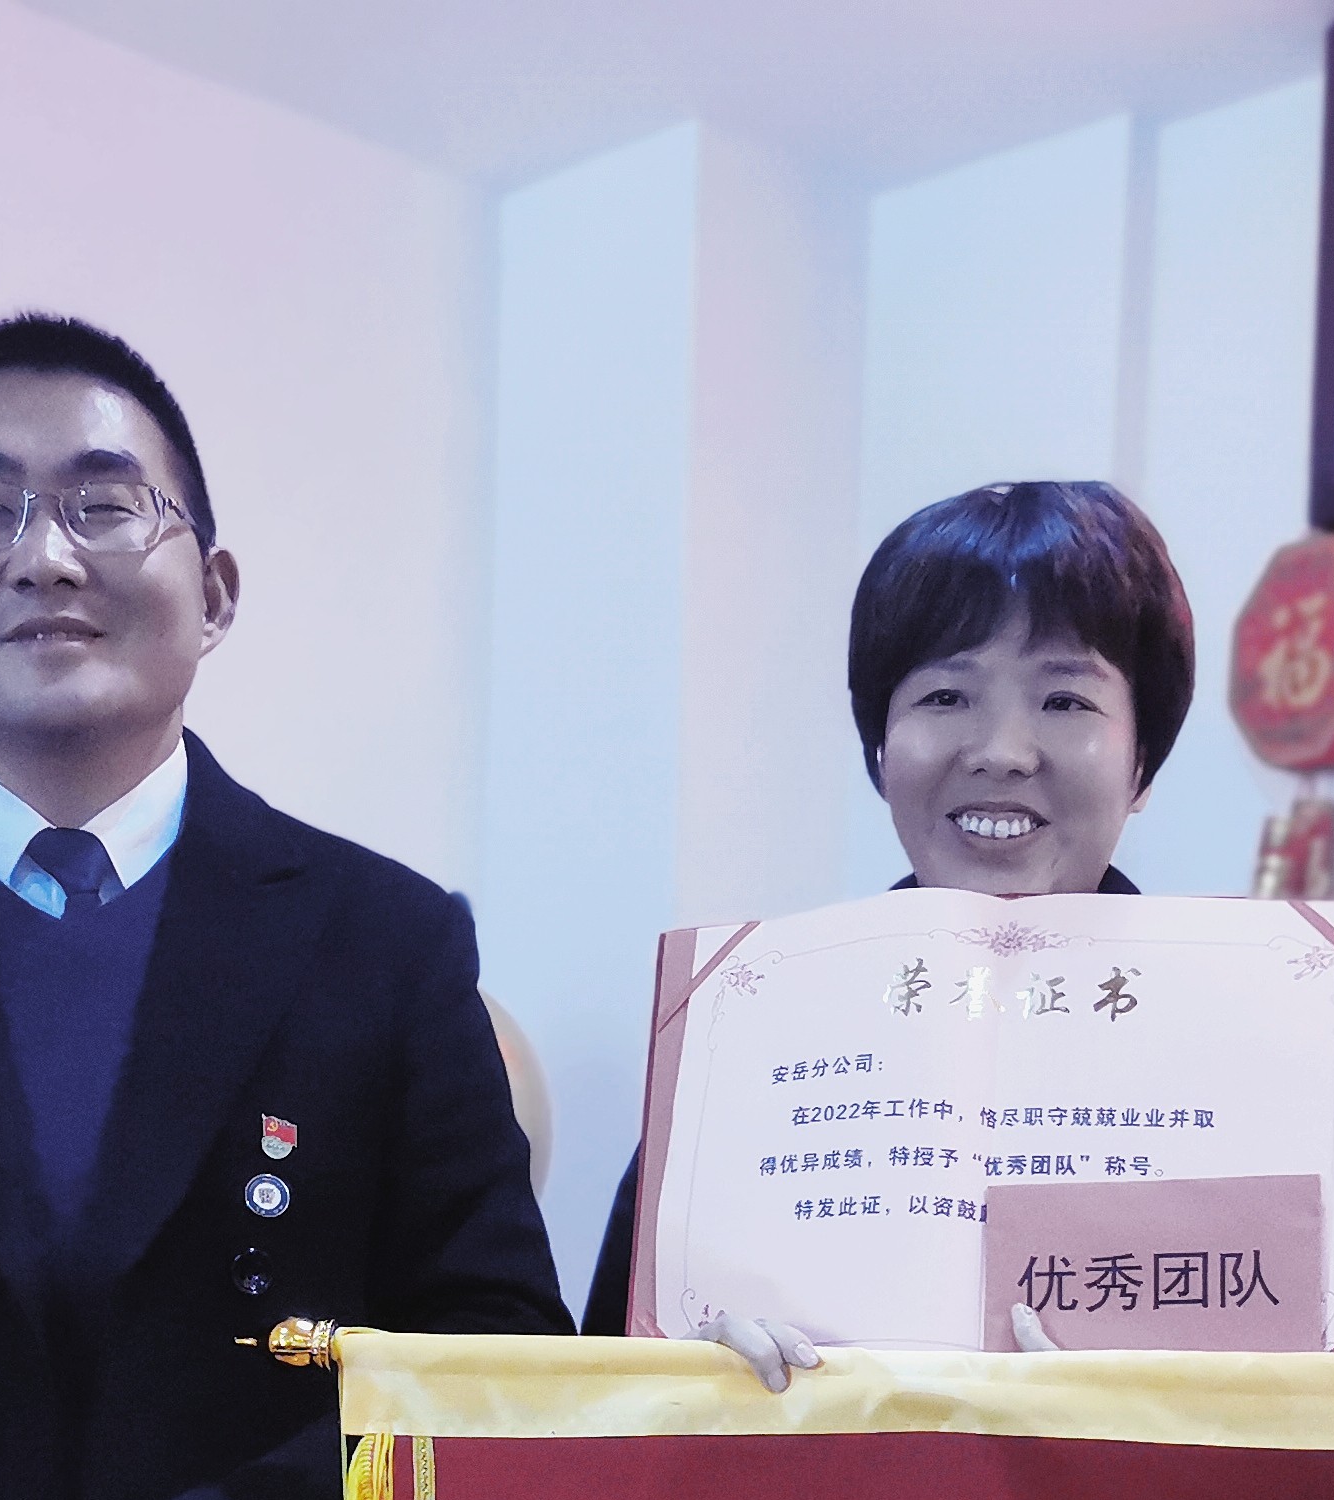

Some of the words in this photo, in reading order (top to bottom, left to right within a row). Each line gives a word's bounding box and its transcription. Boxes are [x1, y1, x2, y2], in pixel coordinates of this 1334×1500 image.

[883, 957, 1142, 1022] 荣誉证书
[771, 1053, 884, 1085] 安岳分公司：
[1017, 1250, 1280, 1313] 优秀团队
